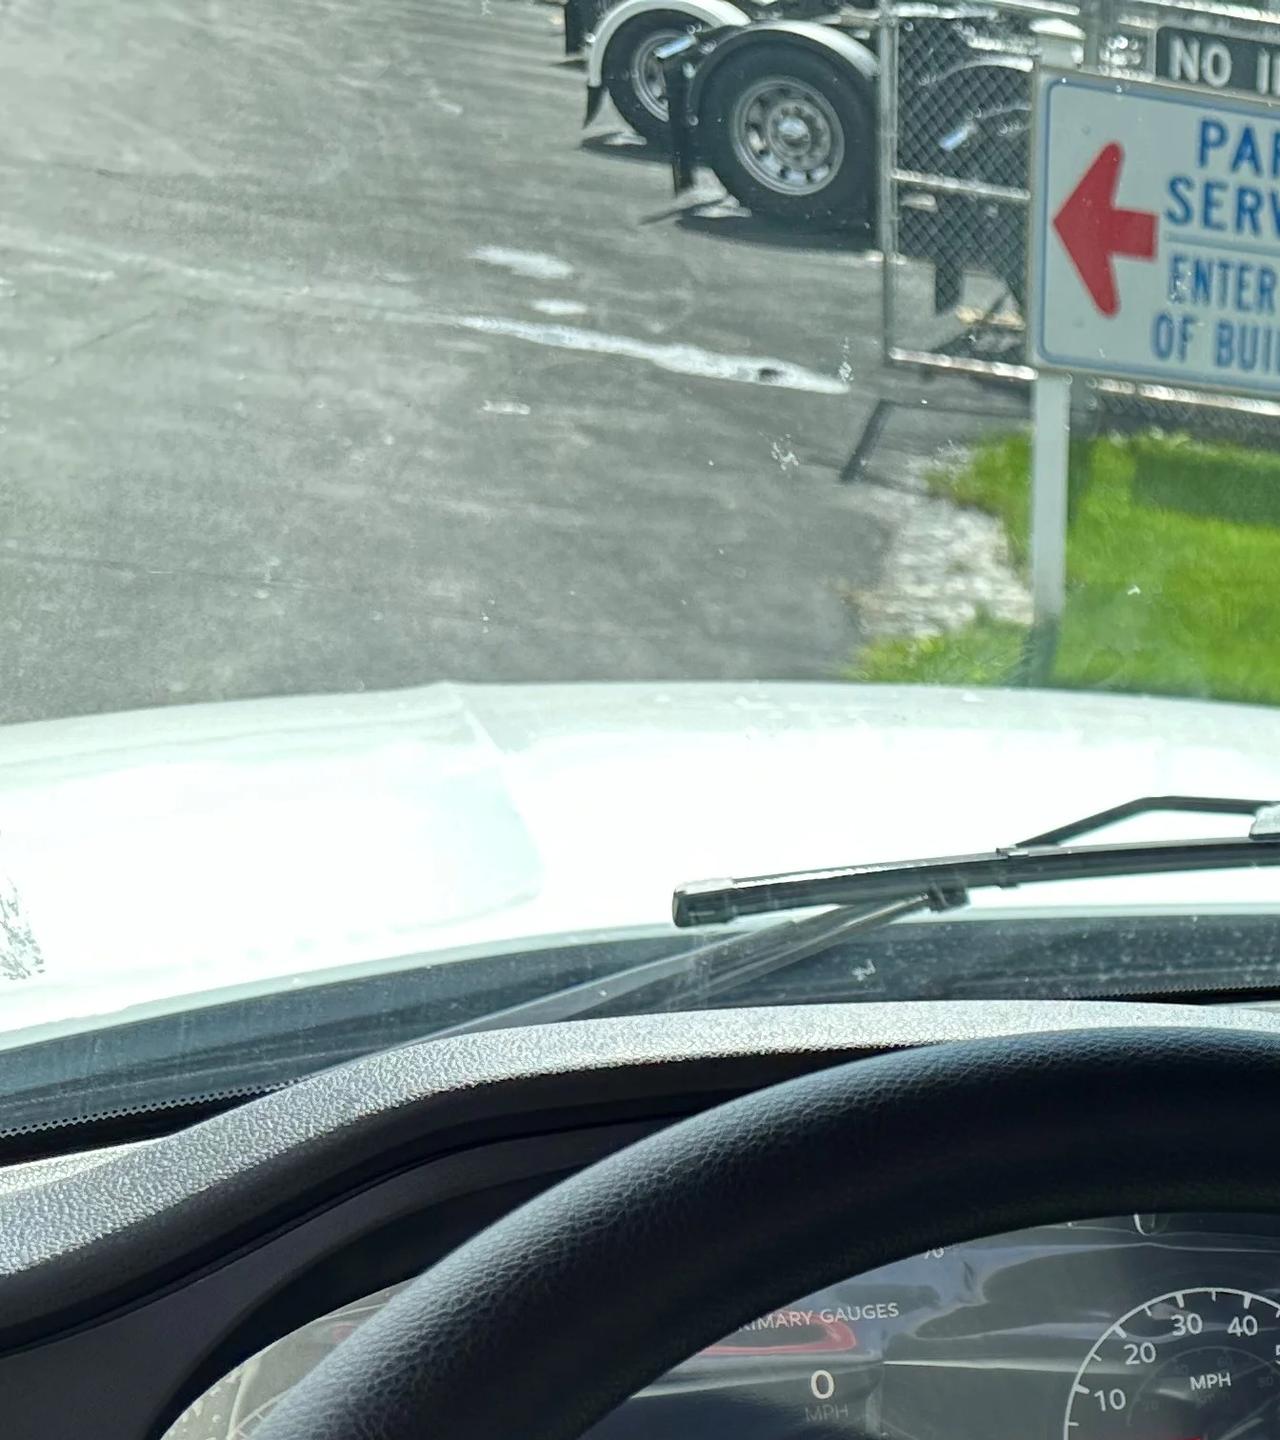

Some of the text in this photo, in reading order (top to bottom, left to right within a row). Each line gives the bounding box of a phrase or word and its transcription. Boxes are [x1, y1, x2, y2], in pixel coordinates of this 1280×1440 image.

[1168, 37, 1232, 88] NO
[1168, 253, 1277, 317] ENTER
[1151, 312, 1198, 362] OF
[819, 1302, 899, 1325] GAUGES
[1170, 1313, 1203, 1336] 30
[1227, 1315, 1258, 1337] 40
[1123, 1342, 1156, 1365] 20
[811, 1369, 835, 1399] 0
[1189, 1372, 1232, 1391] MPH
[1094, 1388, 1126, 1412] 10
[805, 1403, 849, 1422] MPH
